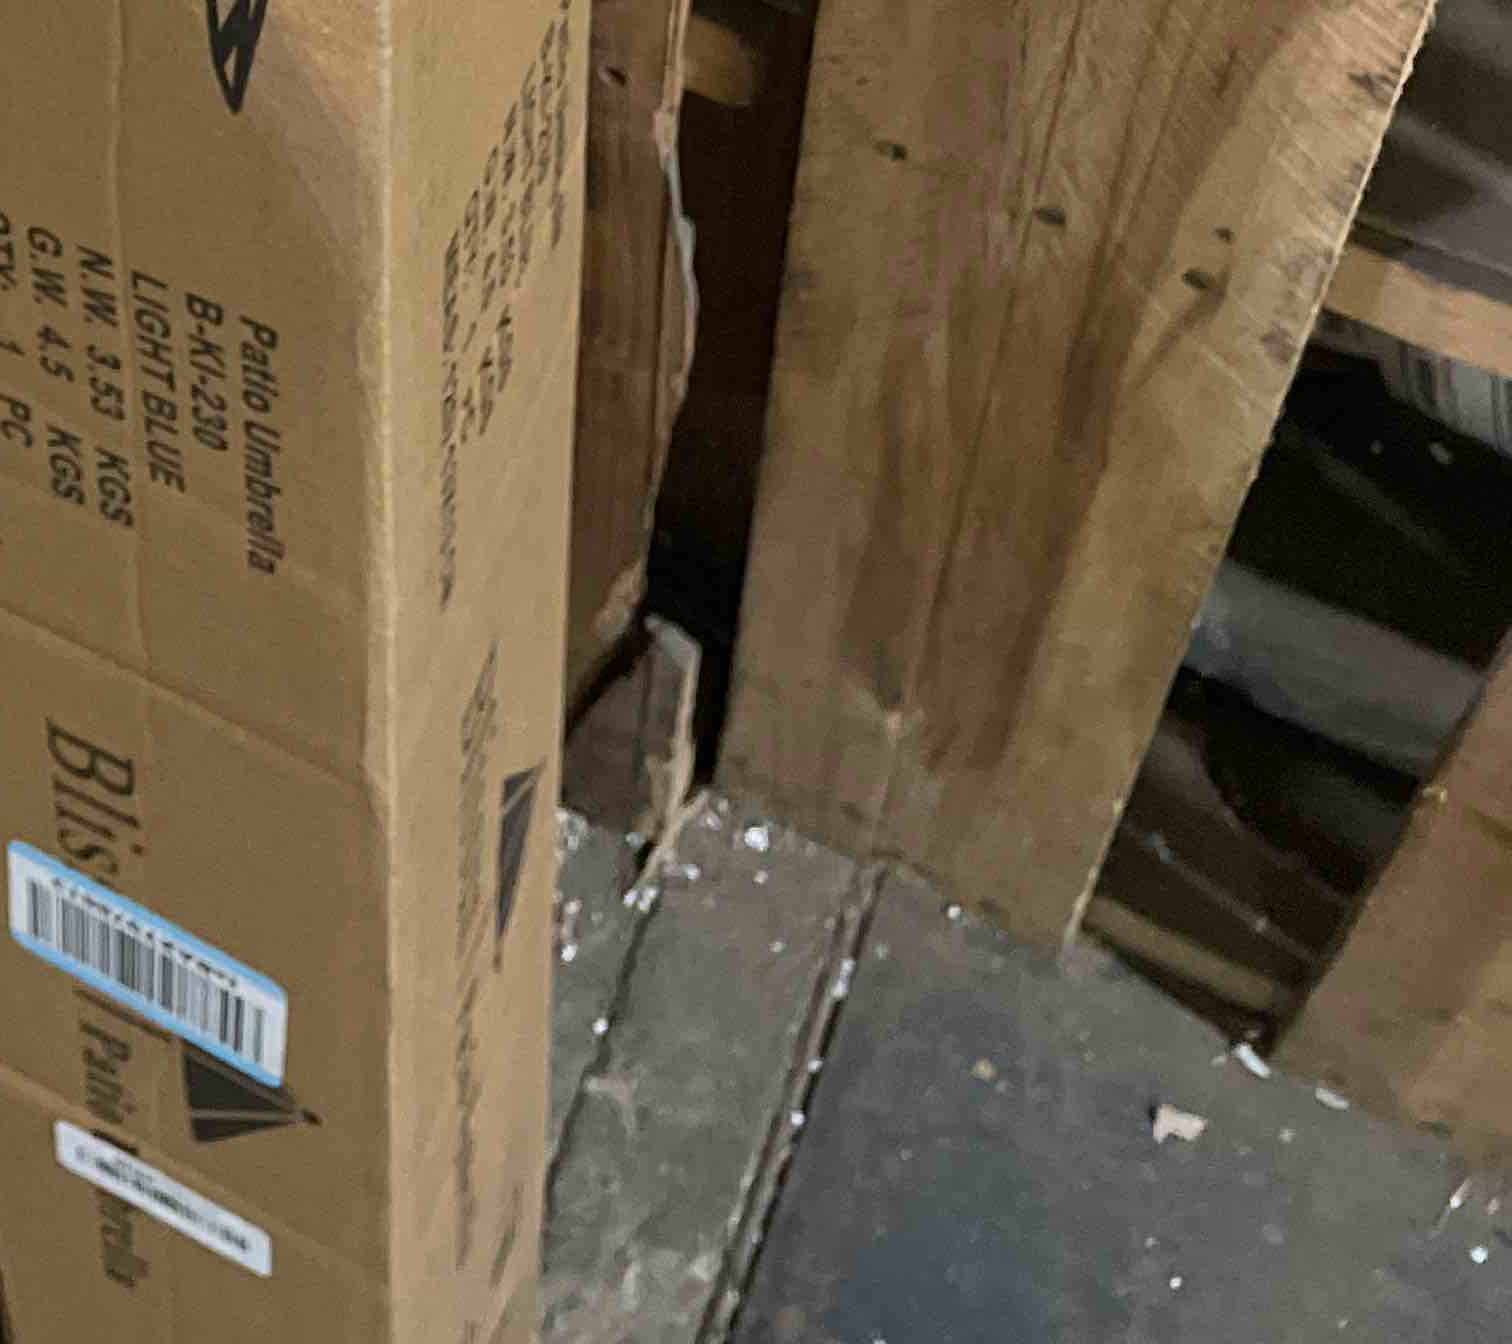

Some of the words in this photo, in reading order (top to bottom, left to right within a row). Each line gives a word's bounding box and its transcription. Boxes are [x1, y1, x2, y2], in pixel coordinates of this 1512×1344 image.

[27, 224, 71, 309] G.W.
[76, 242, 120, 328] N.W.
[37, 326, 75, 384] 4.5
[130, 270, 176, 393] LIGHT
[238, 315, 280, 415] Patio
[46, 424, 88, 508] KGS
[142, 391, 186, 495] BLUE
[95, 446, 135, 529] KGS
[244, 419, 286, 576] Umbrella
